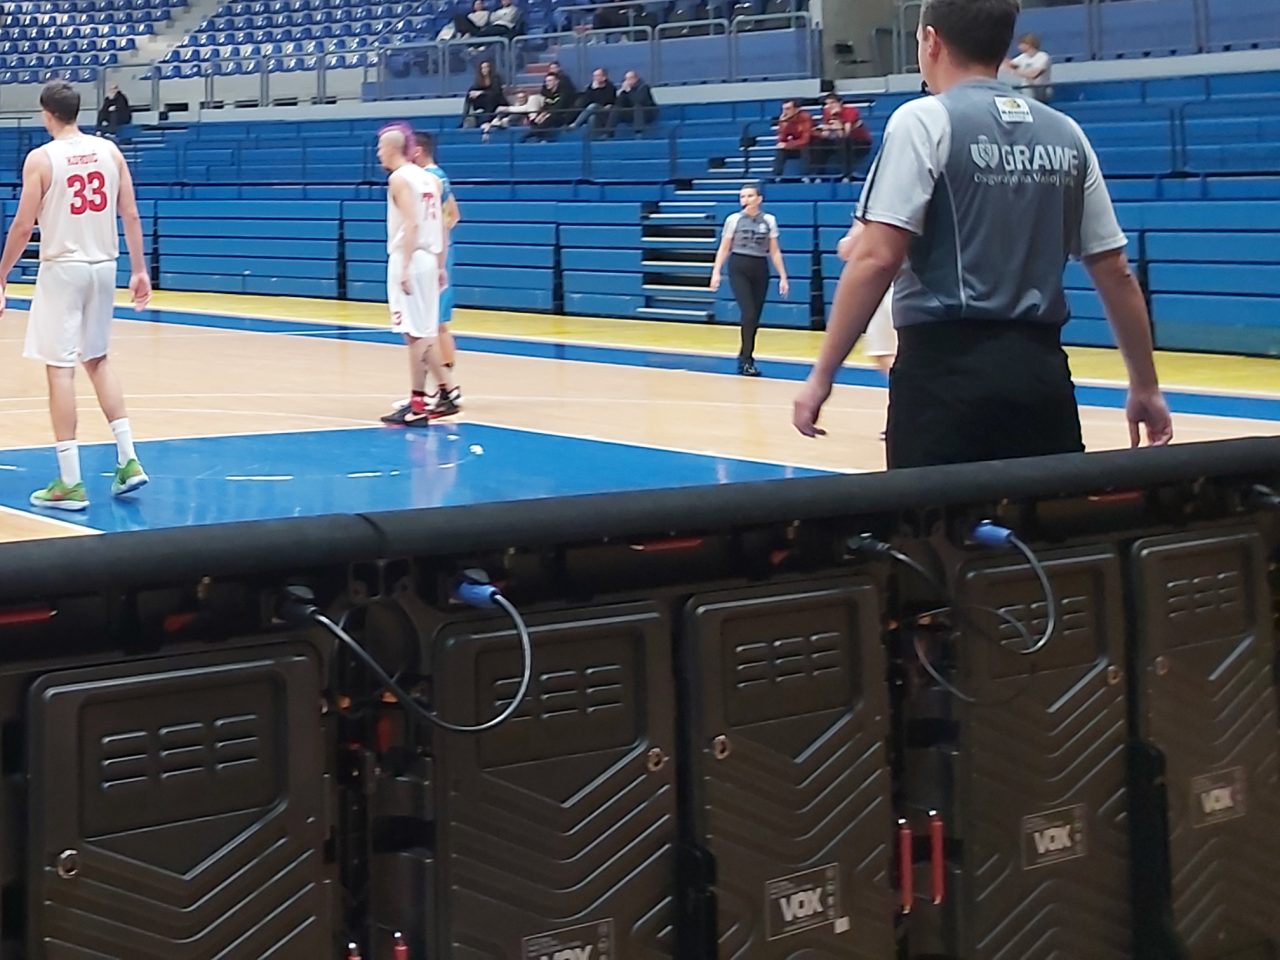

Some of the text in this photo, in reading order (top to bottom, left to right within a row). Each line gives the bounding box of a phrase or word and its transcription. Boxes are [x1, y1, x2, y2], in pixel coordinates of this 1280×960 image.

[1001, 144, 1078, 176] GRAWE
[66, 170, 107, 215] 33
[1033, 825, 1072, 854] VOX
[780, 887, 823, 922] VOX
